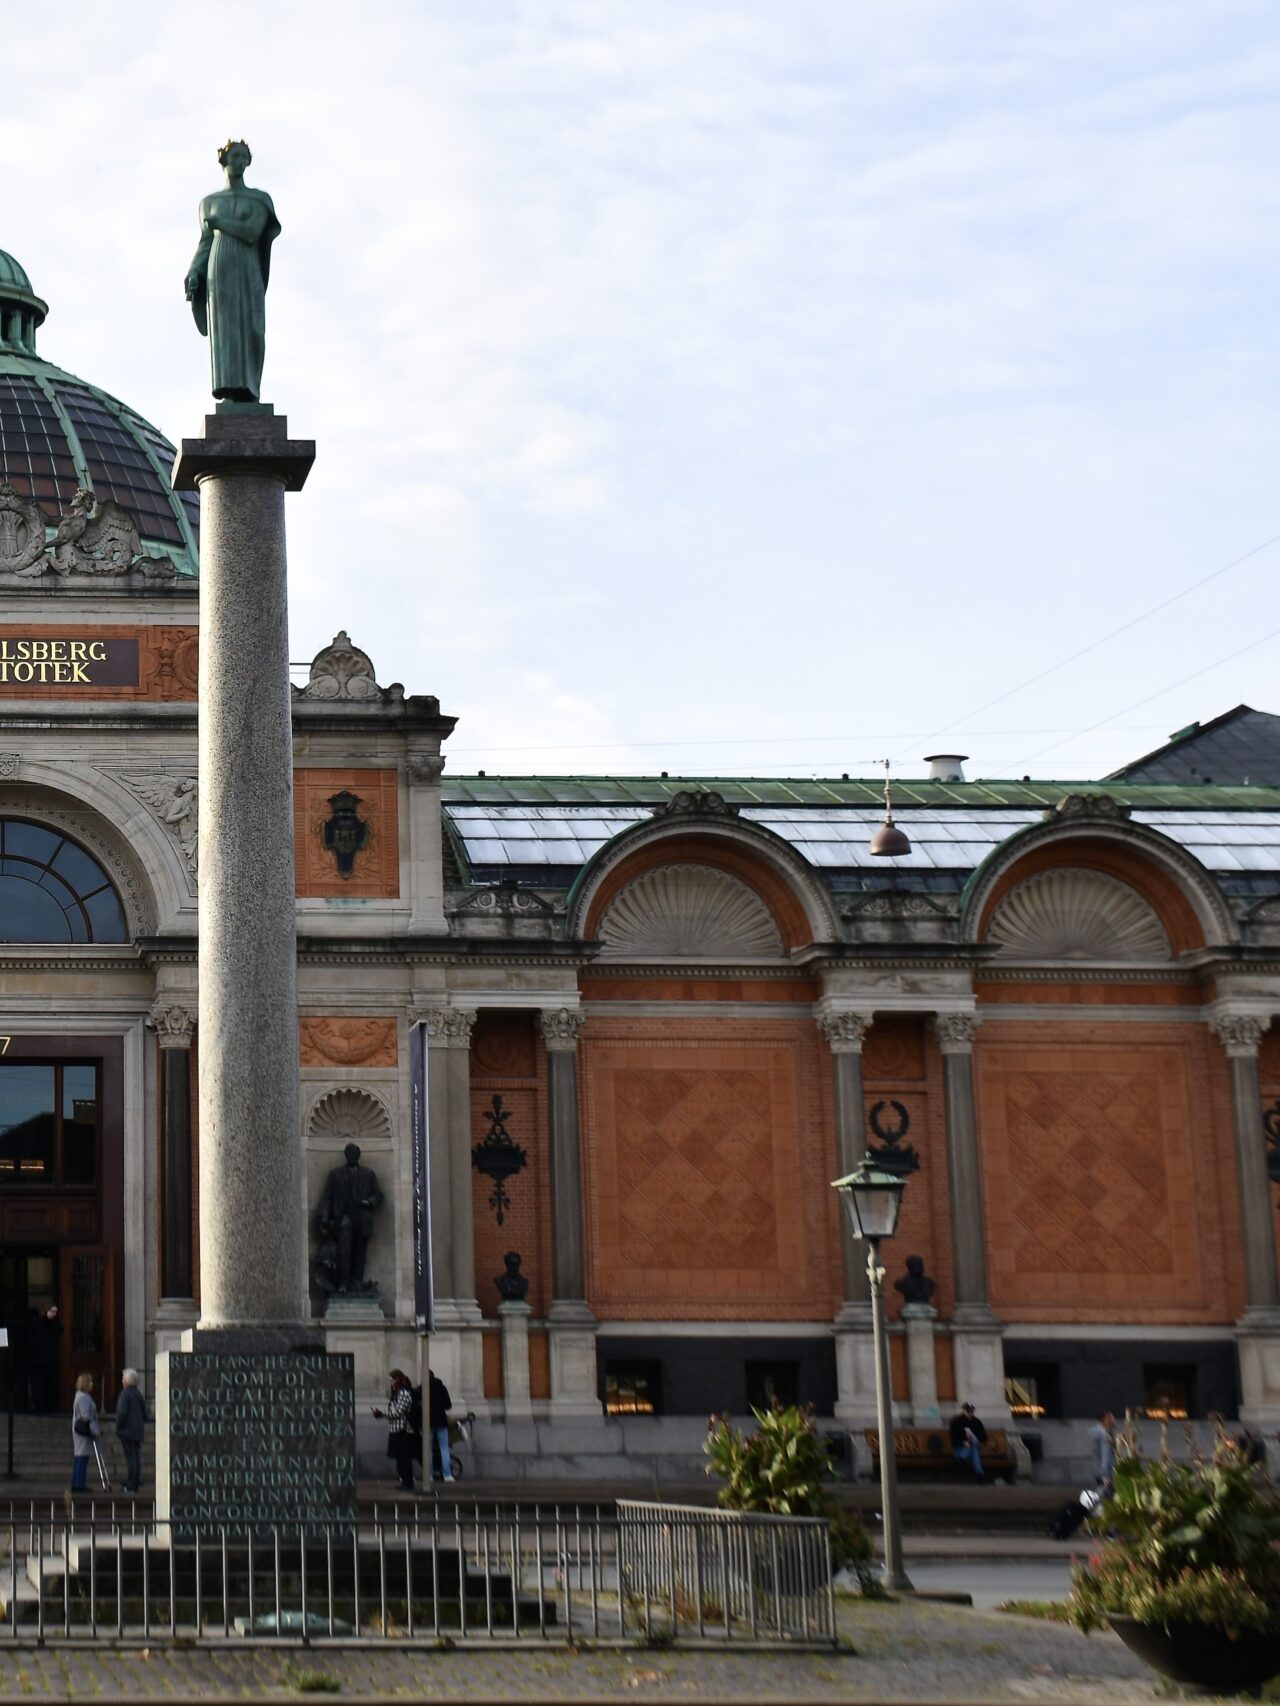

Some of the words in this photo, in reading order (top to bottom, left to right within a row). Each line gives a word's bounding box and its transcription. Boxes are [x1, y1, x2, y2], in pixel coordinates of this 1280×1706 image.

[171, 1355, 219, 1369] RESTI
[228, 1355, 287, 1369] ANCHE
[295, 1354, 330, 1376] QUI
[338, 1356, 352, 1370] IL
[220, 1371, 277, 1387] NOME
[285, 1372, 304, 1386] DI
[171, 1388, 234, 1402] DANTE
[243, 1388, 353, 1402] ALIGHIERI
[171, 1405, 181, 1418] A
[191, 1405, 324, 1418] DOCUMENTO
[334, 1405, 353, 1419] DI
[171, 1421, 224, 1435] CIVILE
[258, 1438, 283, 1452] AD
[171, 1454, 327, 1469] AMMONIMENTO
[334, 1455, 354, 1469] DI
[171, 1471, 217, 1486] BENE
[223, 1471, 255, 1486] PER
[195, 1487, 252, 1503] NELLA
[260, 1487, 331, 1503] INTIMA
[171, 1504, 289, 1520] CONCORDIA
[295, 1504, 330, 1520] TRA
[335, 1505, 356, 1520] LA
